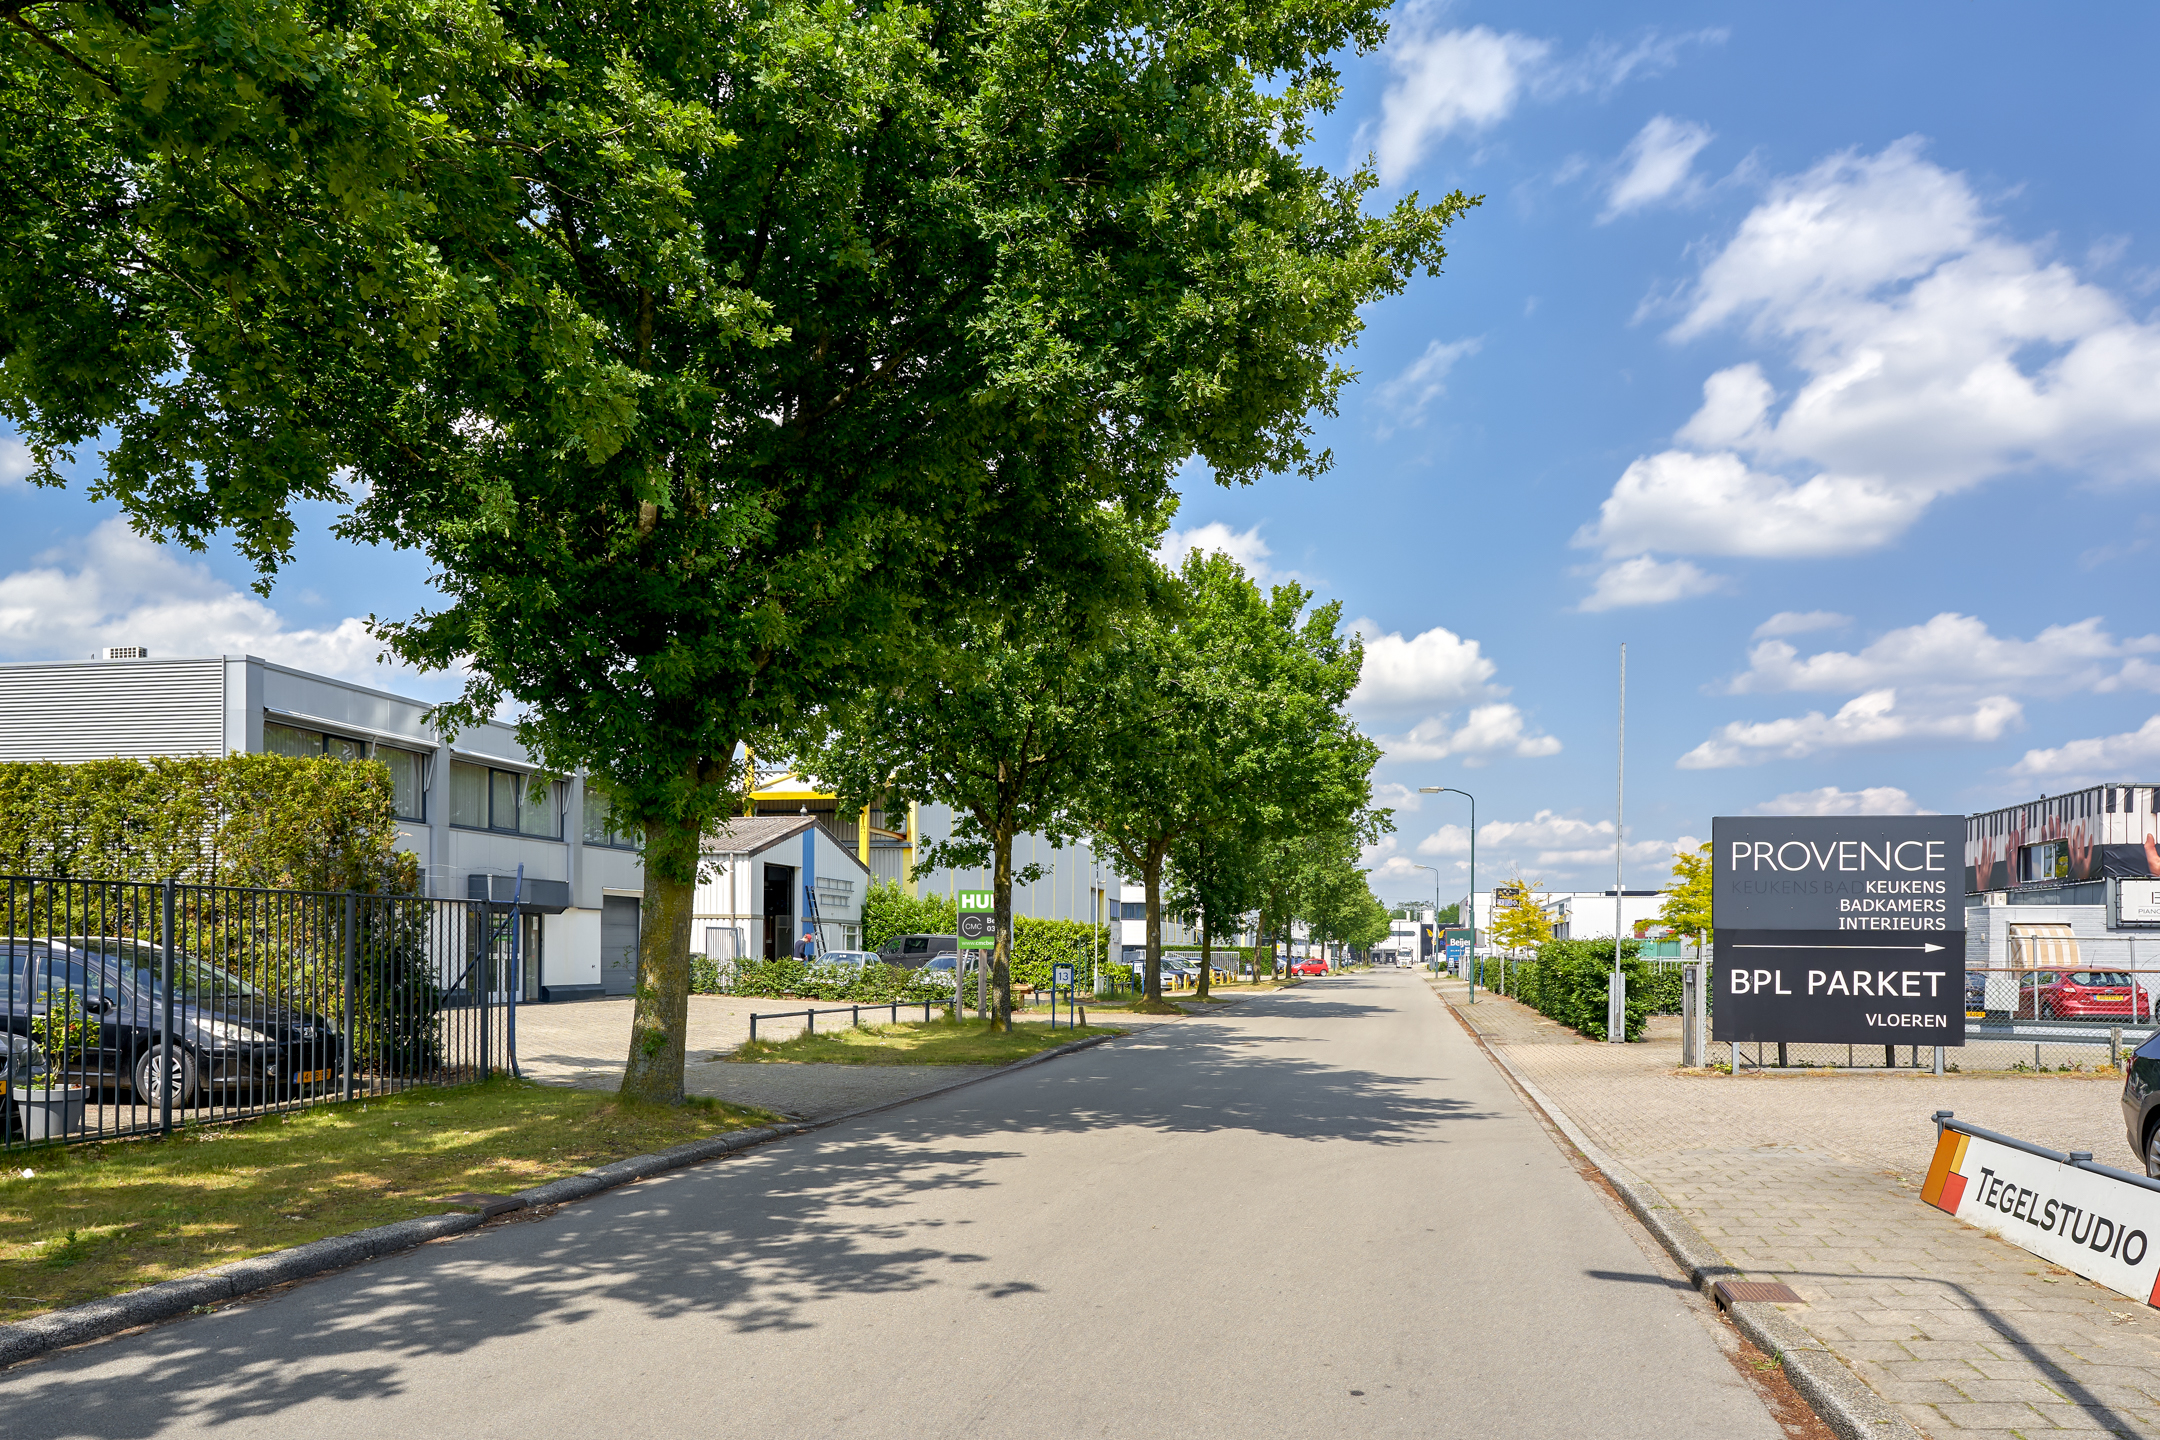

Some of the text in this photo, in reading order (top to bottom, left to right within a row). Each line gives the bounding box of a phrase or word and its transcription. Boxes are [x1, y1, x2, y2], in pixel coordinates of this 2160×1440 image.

[1731, 840, 1946, 872] PROVENCE
[1866, 880, 1946, 894] KEUKENS
[1840, 898, 1946, 913] BADKAMERS
[1838, 916, 1946, 930] INTERIEURS
[1058, 972, 1069, 981] 13
[1730, 969, 1946, 997] BPL PARKET
[1865, 1013, 1947, 1028] VLOEREN
[1975, 1166, 2148, 1266] TEGELSTUDIO
